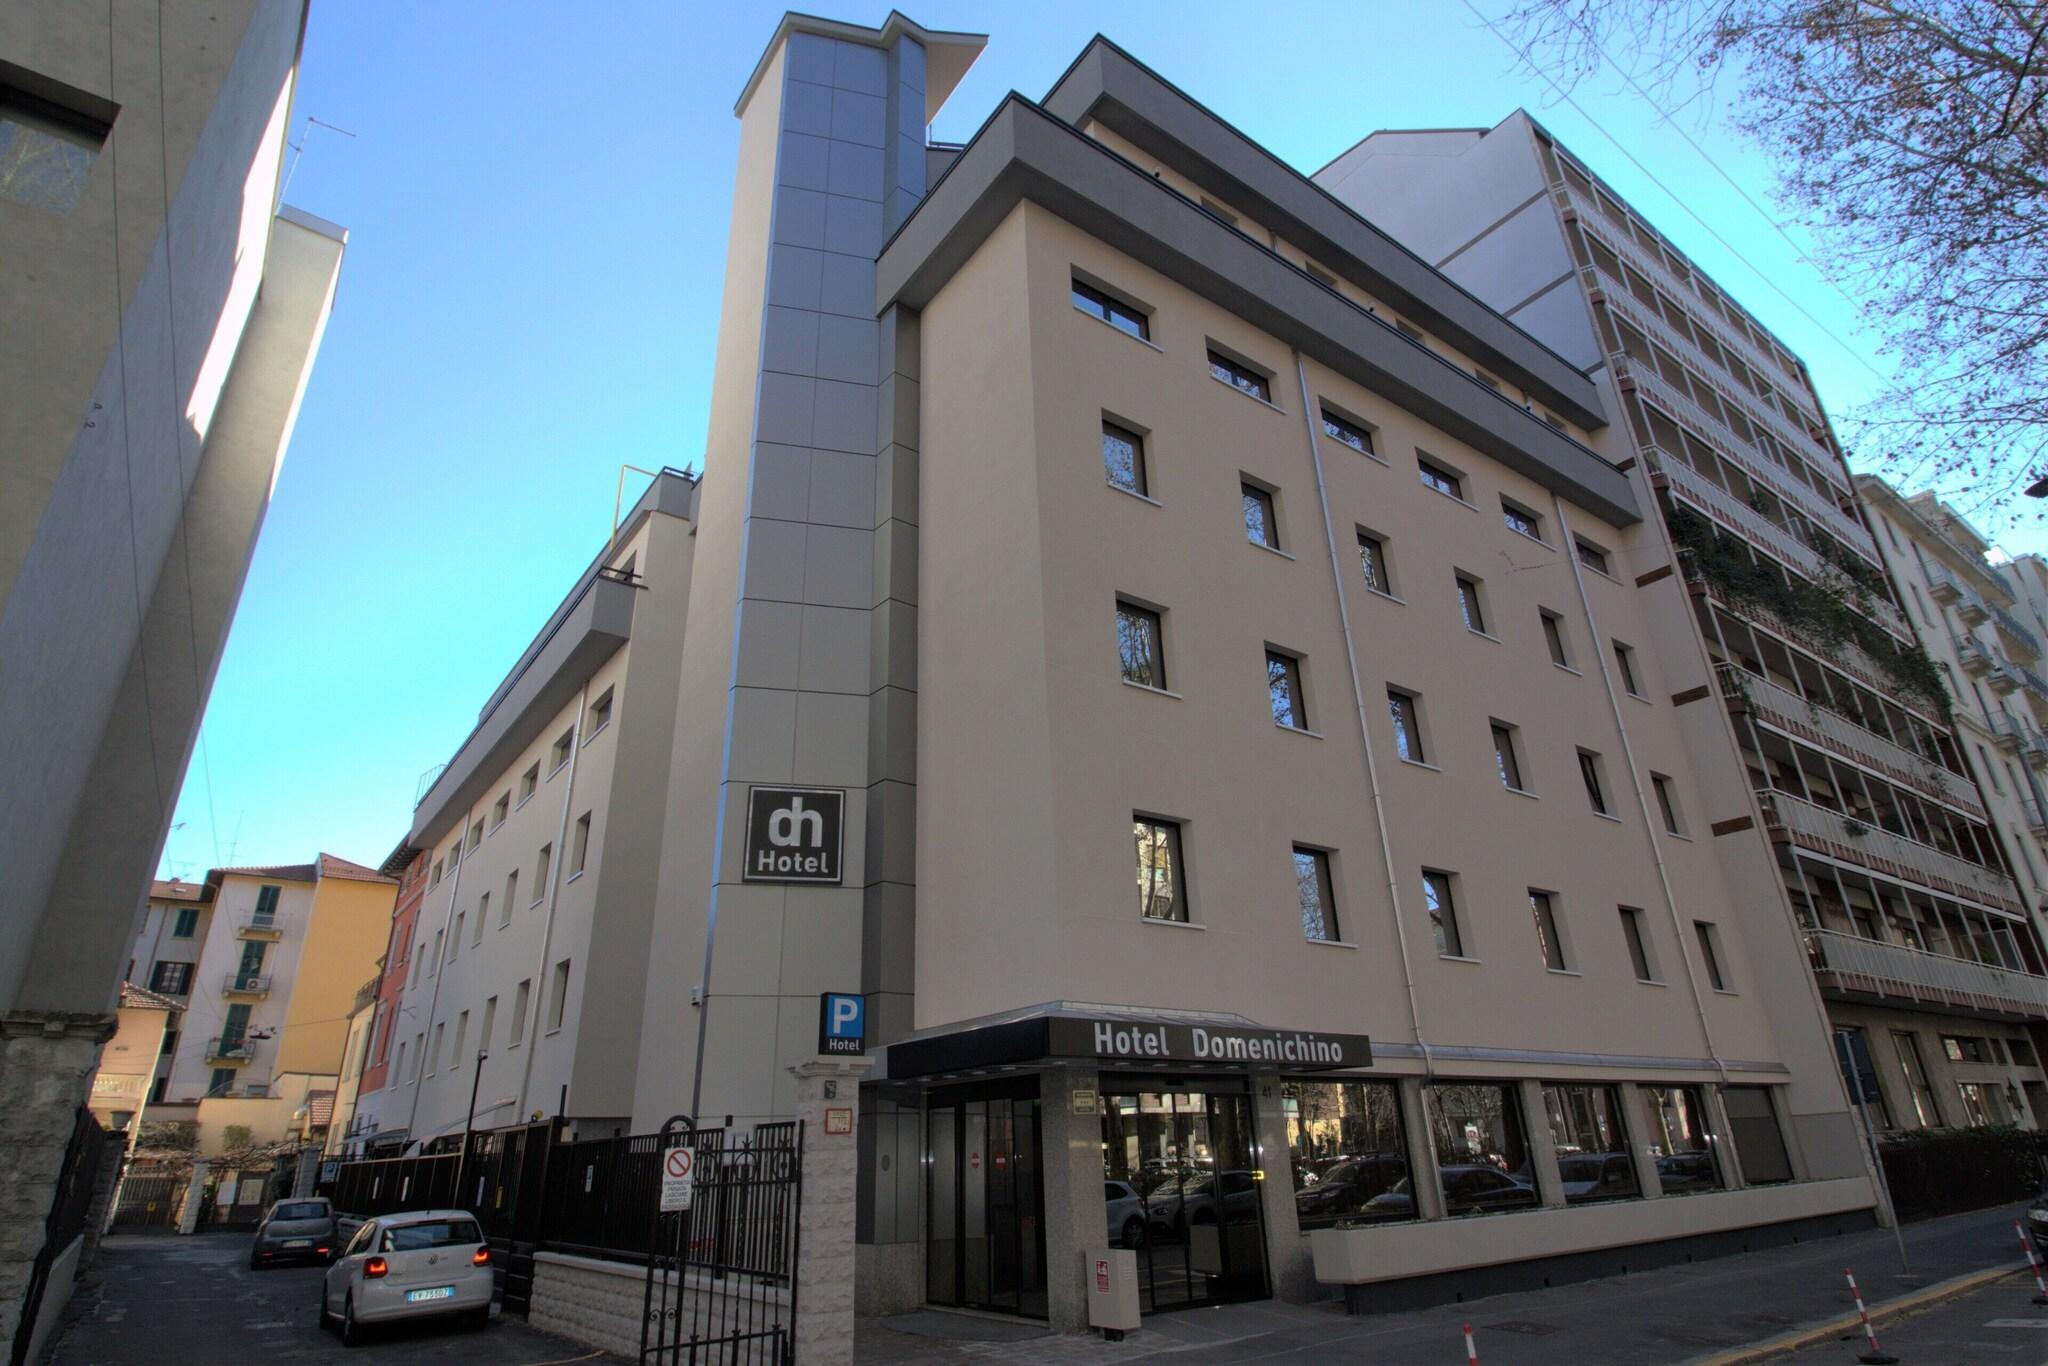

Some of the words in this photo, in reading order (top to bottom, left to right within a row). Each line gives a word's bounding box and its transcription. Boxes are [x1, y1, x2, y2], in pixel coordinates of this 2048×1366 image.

[758, 850, 829, 873] Hotel
[833, 998, 858, 1034] P
[829, 1038, 860, 1051] Hotel
[1094, 1022, 1170, 1056] Hotel
[1191, 1028, 1344, 1063] Domenichino
